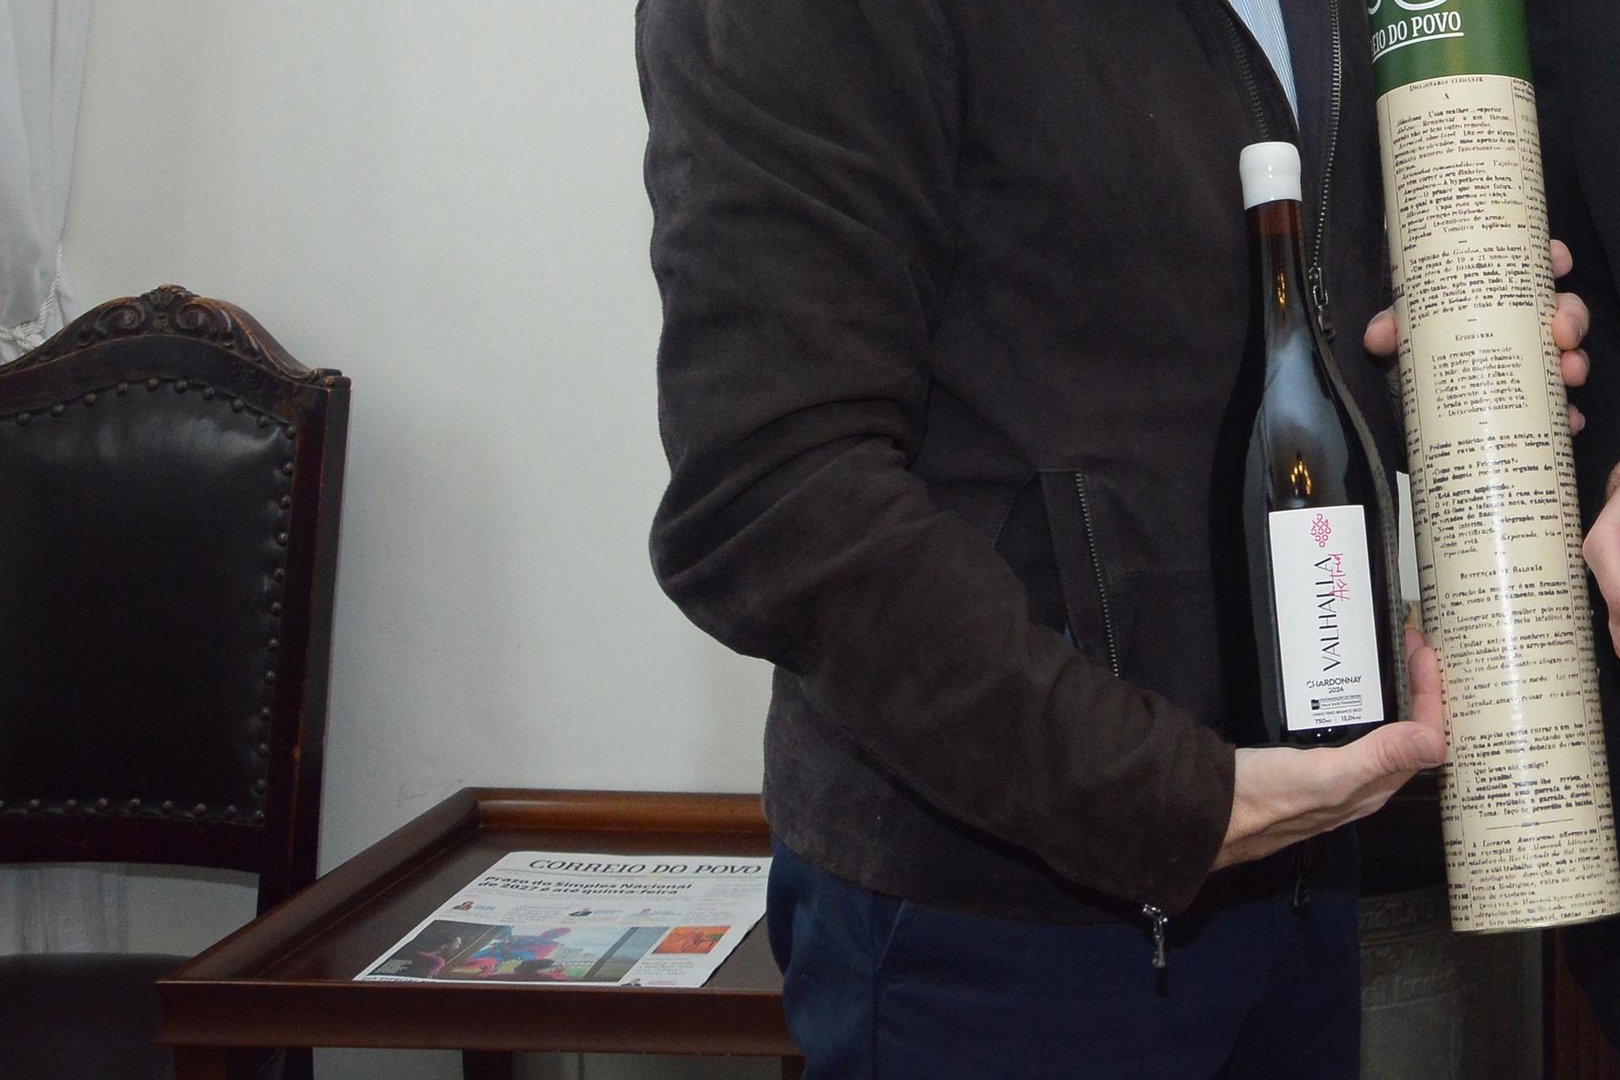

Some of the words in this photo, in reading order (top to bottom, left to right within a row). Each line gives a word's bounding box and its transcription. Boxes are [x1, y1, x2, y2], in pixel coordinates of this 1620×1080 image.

[1388, 21, 1408, 45] DO
[1411, 11, 1462, 38] POVO
[1314, 557, 1341, 671] VALHALLA
[1306, 675, 1362, 689] CHARDONNAY
[529, 860, 645, 874] CORREIO
[652, 864, 689, 874] DO
[694, 865, 762, 875] POVO
[484, 876, 529, 884] Prazo
[555, 881, 618, 890] Simples
[582, 887, 678, 895] quinta-feira
